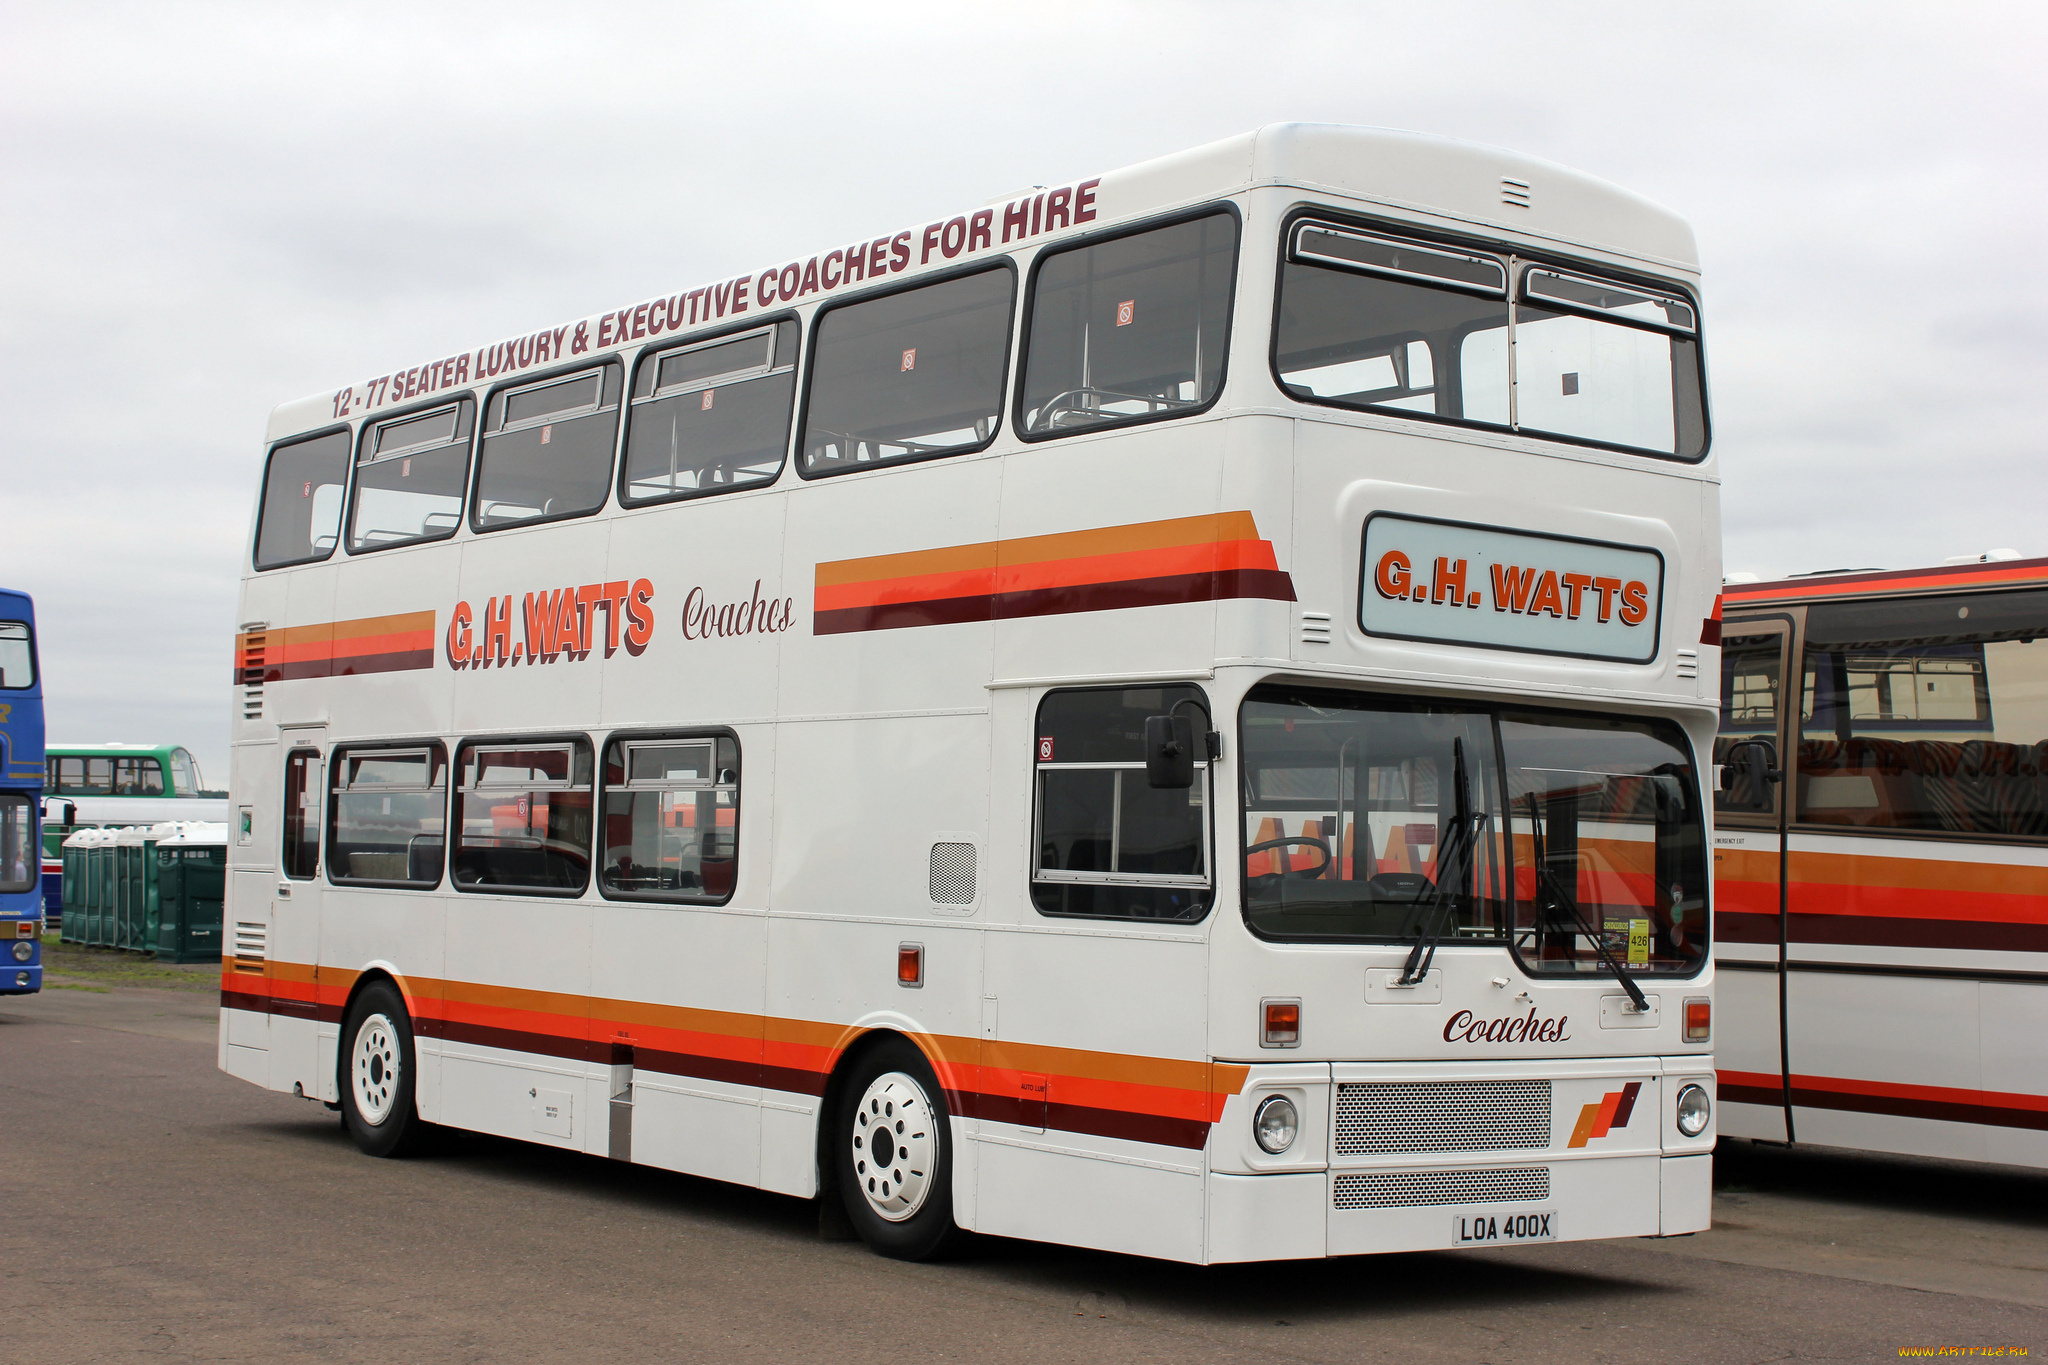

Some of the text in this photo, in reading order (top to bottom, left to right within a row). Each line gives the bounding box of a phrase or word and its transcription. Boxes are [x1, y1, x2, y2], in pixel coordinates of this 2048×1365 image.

[333, 386, 353, 419] 12
[365, 375, 391, 410] 77
[391, 353, 470, 402] SEATER
[475, 327, 566, 380] LUXURY
[571, 320, 589, 352] &
[597, 275, 752, 349] EXECUTIVE
[757, 231, 912, 307] COACHES
[920, 208, 994, 265] FOR
[1001, 177, 1102, 244] HIRE
[1374, 550, 1650, 628] G.H. WATTS
[681, 579, 797, 641] Coaches
[1631, 935, 1648, 947] 426
[1443, 1007, 1572, 1043] Coaches
[1021, 1083, 1034, 1091] AUTO
[1461, 1213, 1551, 1241] LOA 400X
